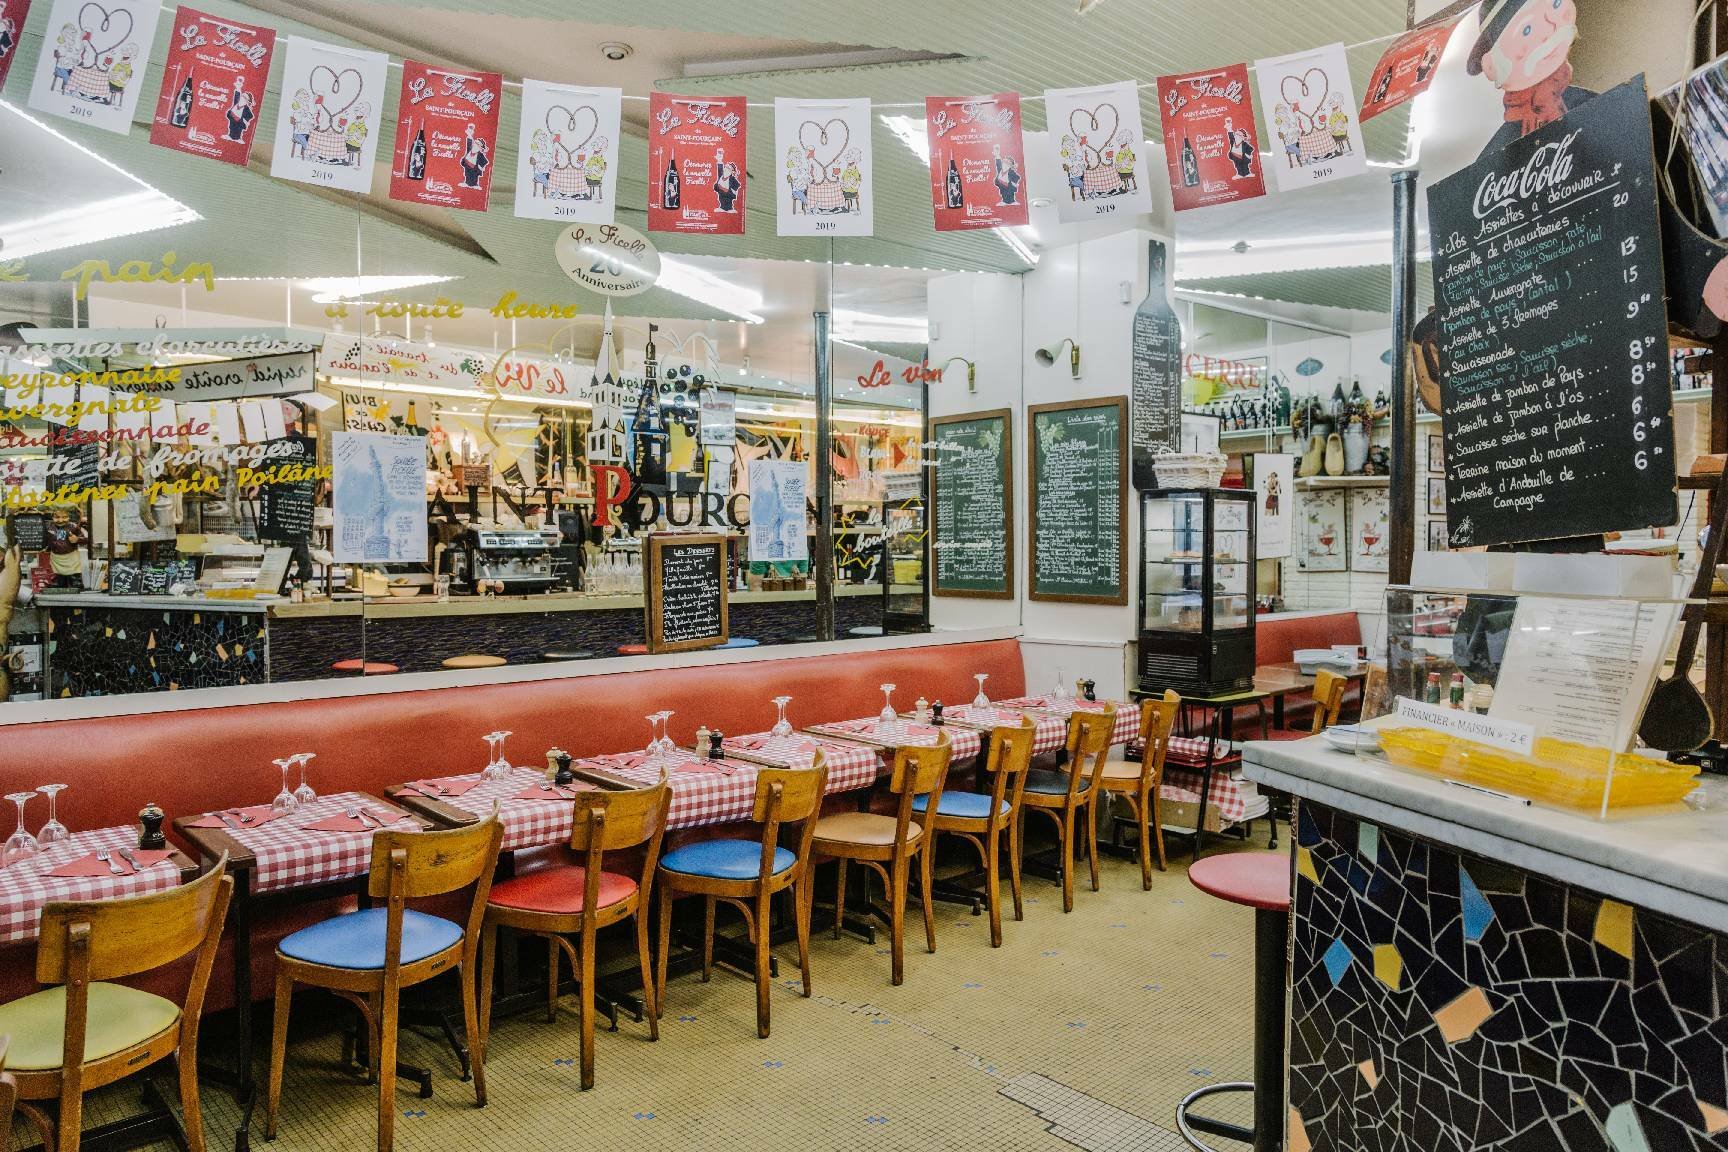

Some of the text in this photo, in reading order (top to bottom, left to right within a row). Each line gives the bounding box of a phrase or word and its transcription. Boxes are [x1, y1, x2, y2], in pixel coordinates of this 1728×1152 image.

[180, 24, 208, 51] La
[408, 77, 435, 105] La
[1164, 89, 1188, 117] La
[69, 105, 93, 119] 2019
[656, 107, 681, 135] La
[932, 110, 957, 137] La
[311, 169, 334, 182] 2019
[1312, 166, 1333, 180] 2019
[1473, 128, 1582, 219] Coca-Cola
[553, 206, 576, 217] 2019
[1095, 202, 1116, 215] 2019
[1473, 206, 1525, 240] Assiettes
[571, 228, 594, 251] La
[815, 221, 836, 231] 2019
[1445, 250, 1483, 280] Assiette
[1487, 242, 1500, 259] de
[1613, 191, 1629, 208] 20
[60, 251, 215, 300] pain
[489, 290, 579, 320] heure
[1446, 295, 1482, 320] Assiette
[1488, 272, 1547, 304] Auvergnate
[1448, 264, 1638, 350] Assiette de 3 fromages 15
[1626, 301, 1639, 319] 9
[857, 359, 943, 389] Le vin
[1452, 392, 1488, 414] Assiette
[1491, 388, 1503, 402] de
[1504, 380, 1539, 407] jambon
[1542, 372, 1556, 388] de
[1558, 365, 1585, 389] Pays
[1629, 340, 1643, 360] 8
[1454, 413, 1489, 437] Assiette
[1492, 410, 1504, 424] de
[1508, 401, 1542, 427] jambon
[1556, 388, 1585, 408] l'os
[1631, 364, 1645, 385] 8
[1456, 438, 1499, 457] Saucisse
[1554, 410, 1593, 442] planche
[1631, 395, 1643, 415] 6
[100, 450, 132, 471] de
[1495, 455, 1527, 472] maison
[1529, 447, 1543, 464] du
[1547, 436, 1586, 460] moment
[1633, 421, 1647, 442] 6
[5, 463, 333, 508] tartines pain Poilâne
[1456, 481, 1494, 502] Assiette
[1559, 464, 1576, 482] de
[1634, 450, 1648, 470] 6
[426, 485, 565, 526] AINT
[1493, 493, 1545, 513] Campagne
[1401, 705, 1449, 727] FINANCIER
[1457, 719, 1495, 737] MAISON
[1510, 732, 1517, 743] 2
